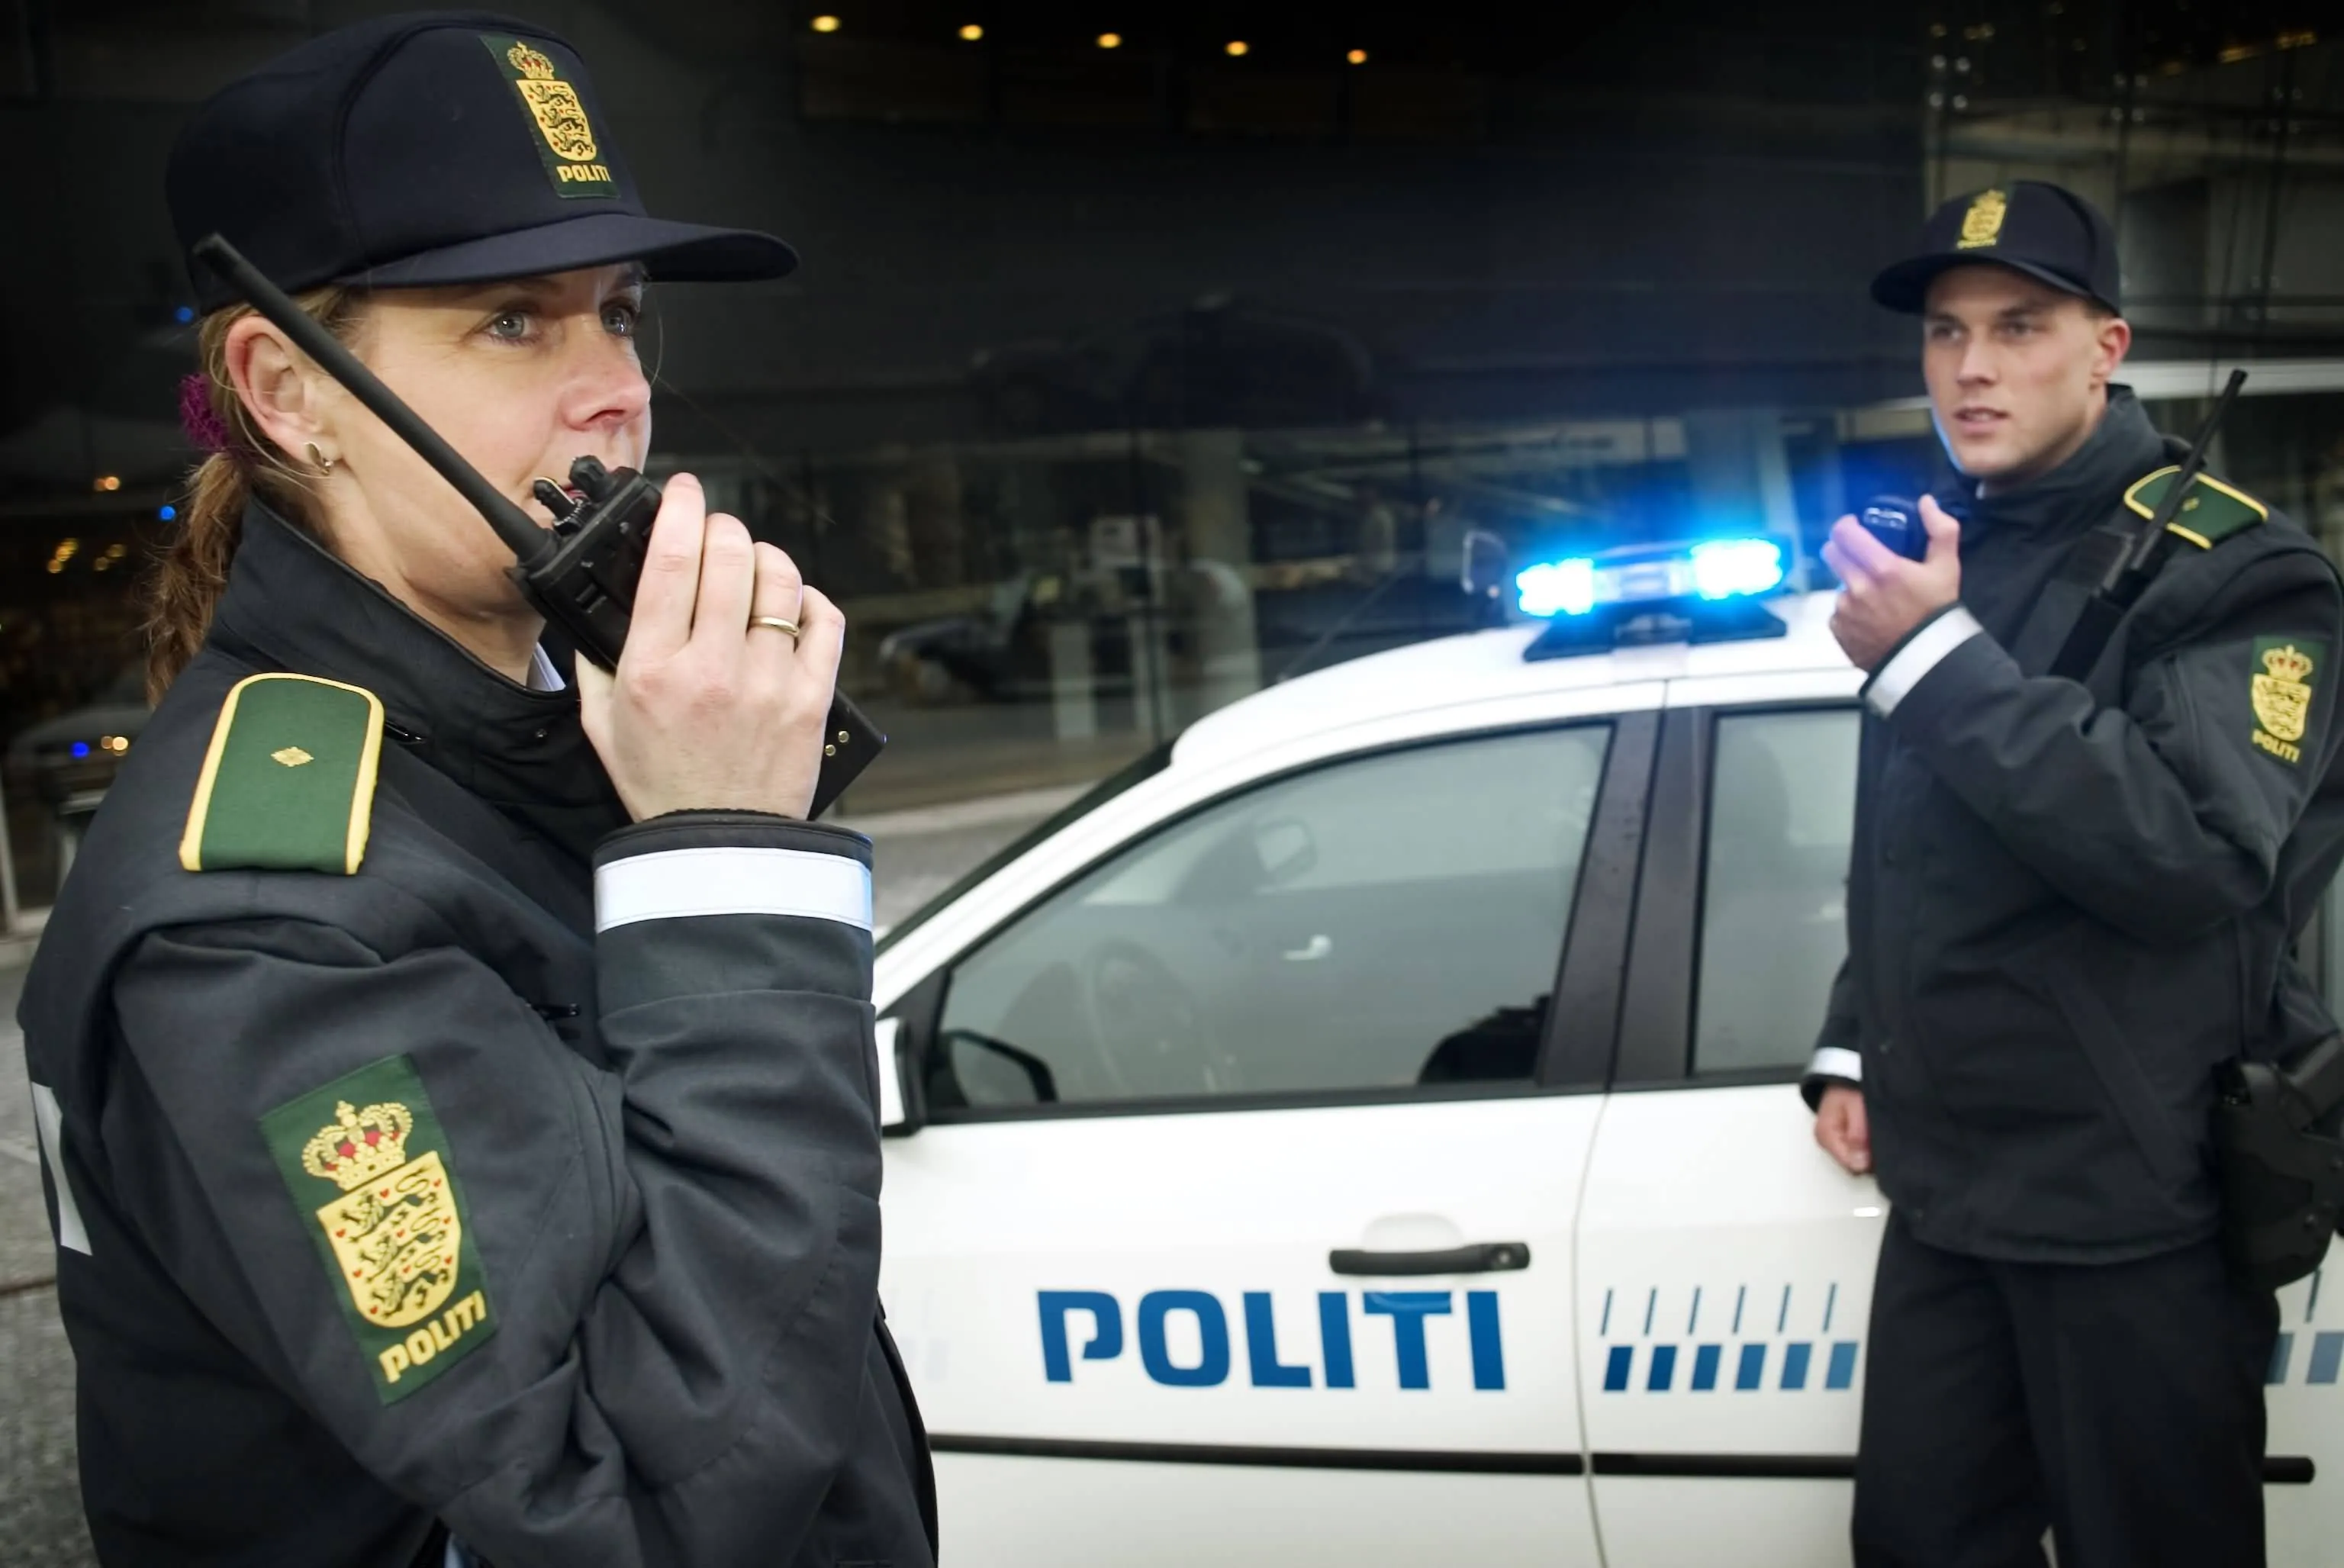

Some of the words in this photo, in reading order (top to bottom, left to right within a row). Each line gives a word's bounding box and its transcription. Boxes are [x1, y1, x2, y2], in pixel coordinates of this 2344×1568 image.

[556, 164, 611, 182] POLITI
[2252, 728, 2301, 762] POLITI
[378, 1289, 487, 1383] POLITI
[1036, 1289, 1506, 1391] POLITI
